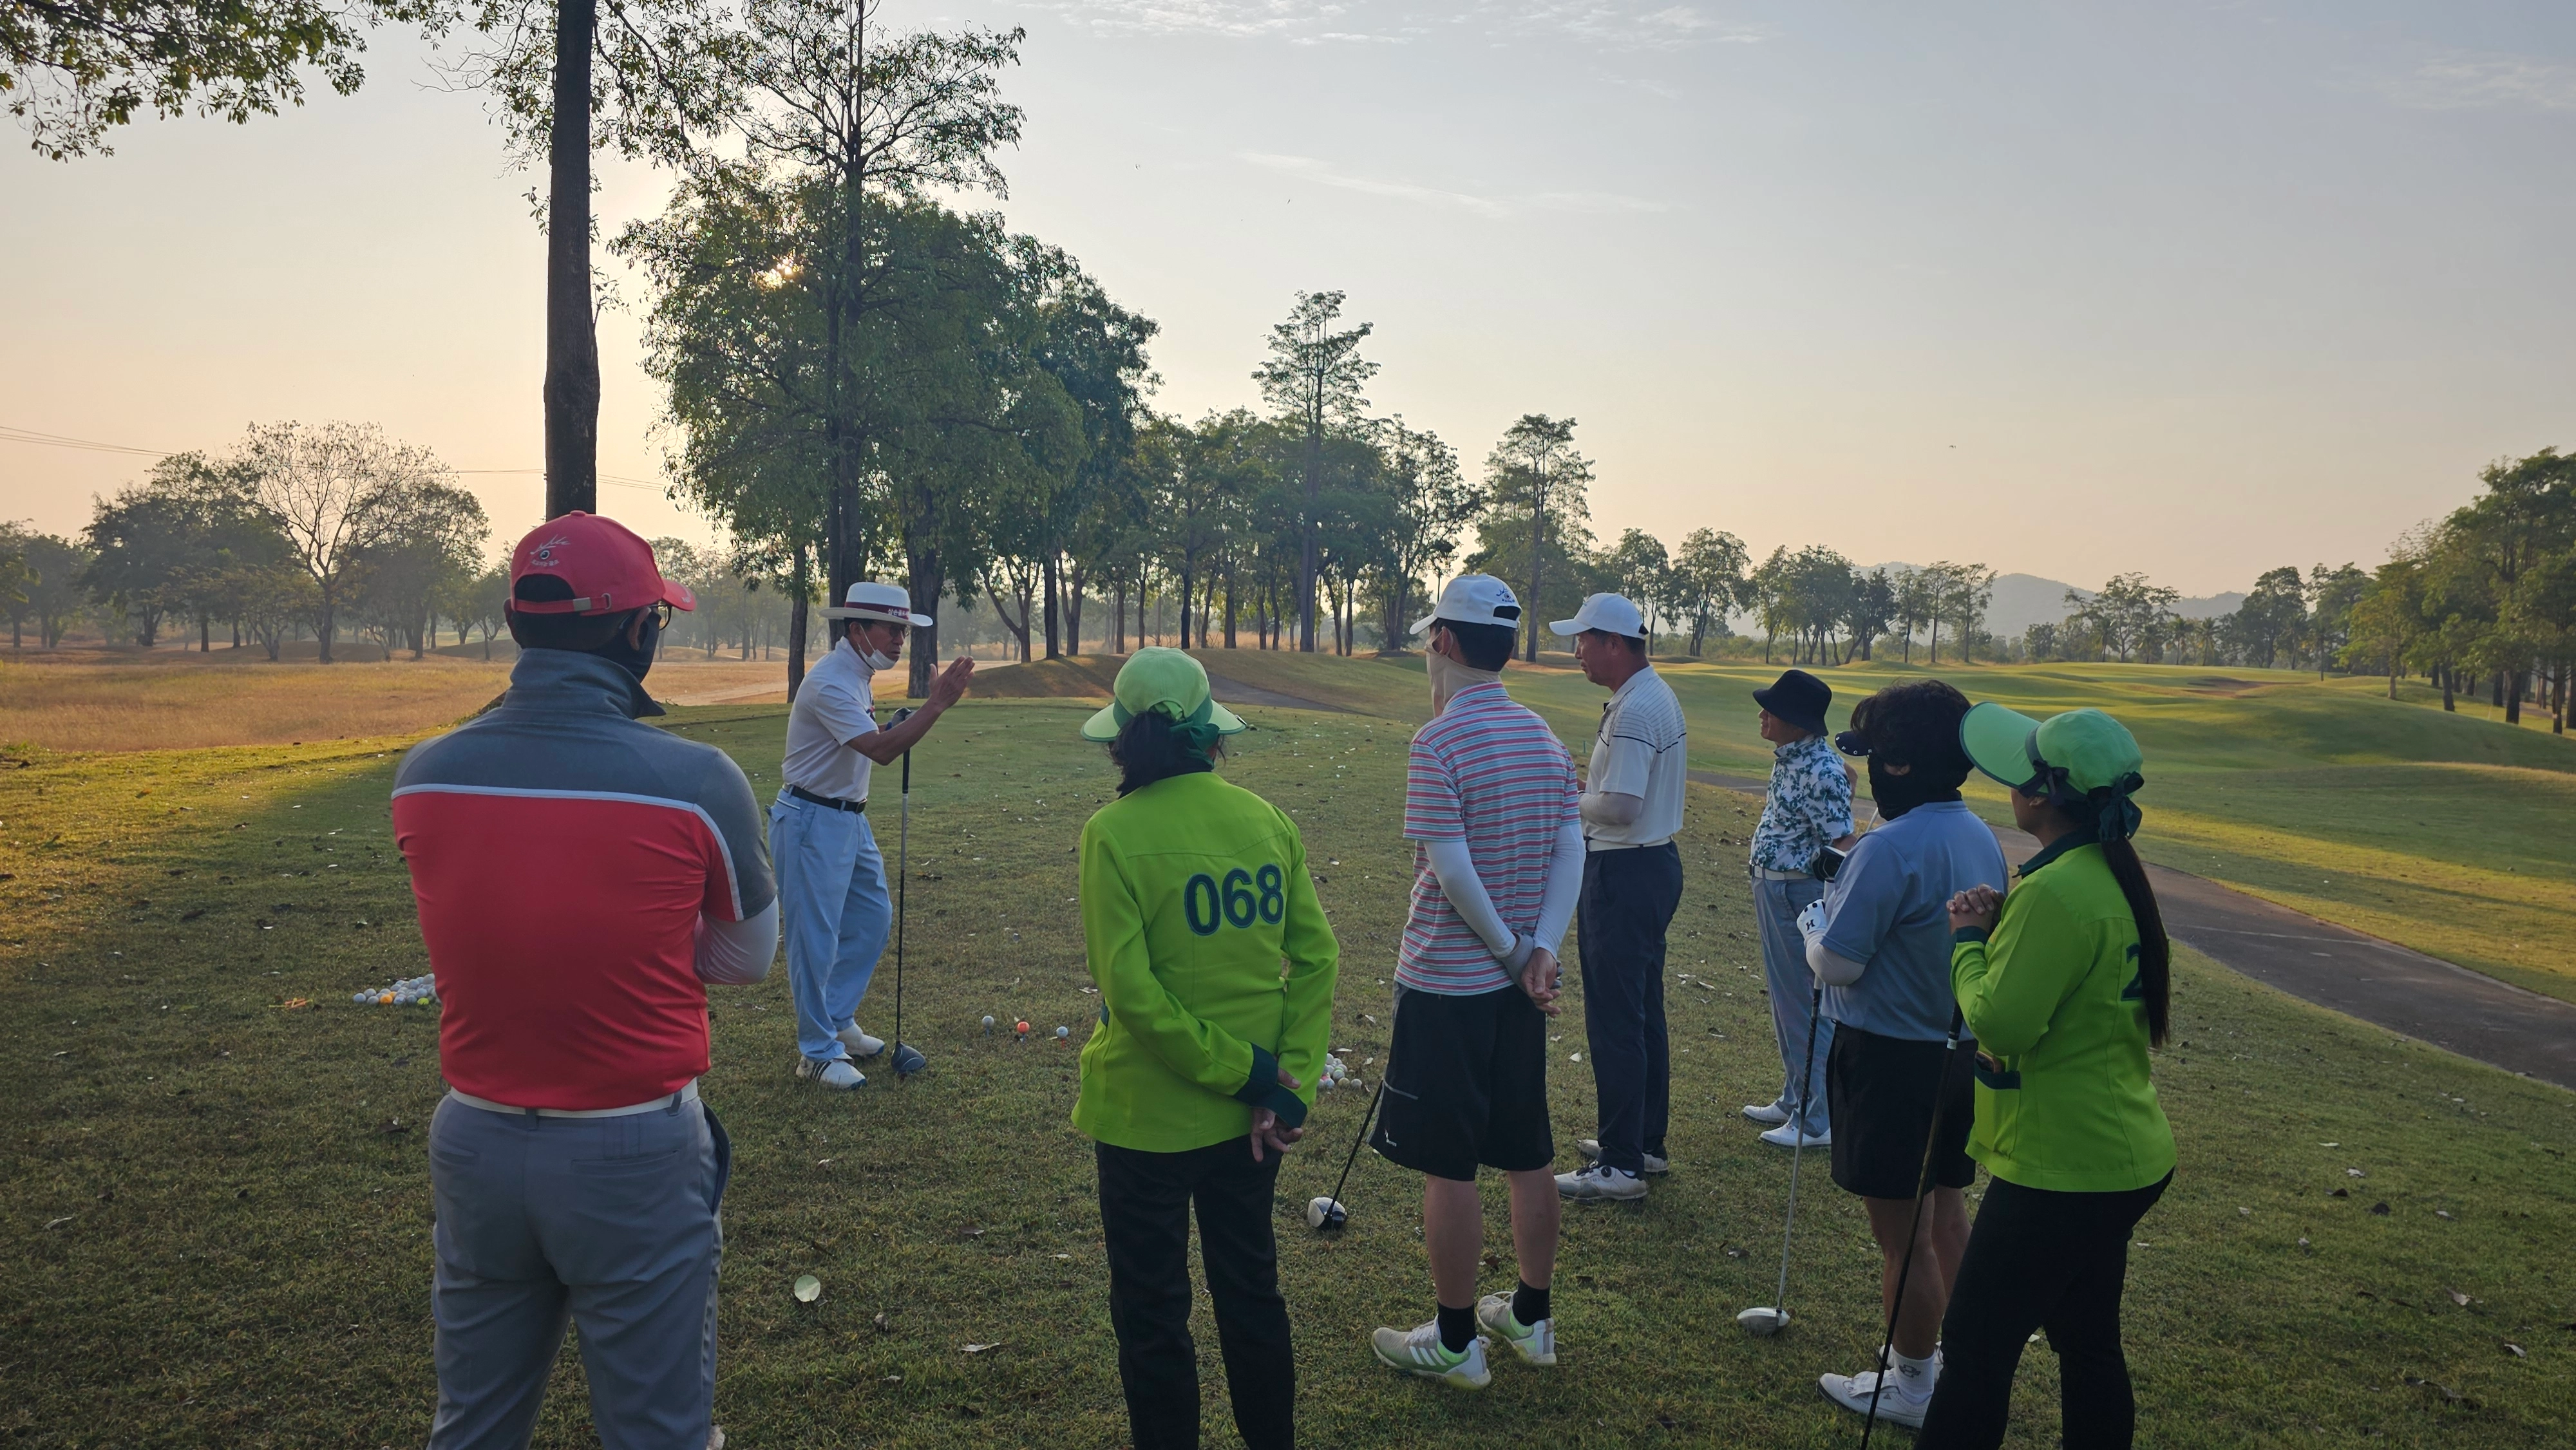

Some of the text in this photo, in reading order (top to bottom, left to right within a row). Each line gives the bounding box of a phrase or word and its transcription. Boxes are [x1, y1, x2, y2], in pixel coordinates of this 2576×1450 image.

[1835, 736, 1872, 755] SPOR
[1184, 863, 1284, 936] 068
[1806, 919, 1815, 931] H
